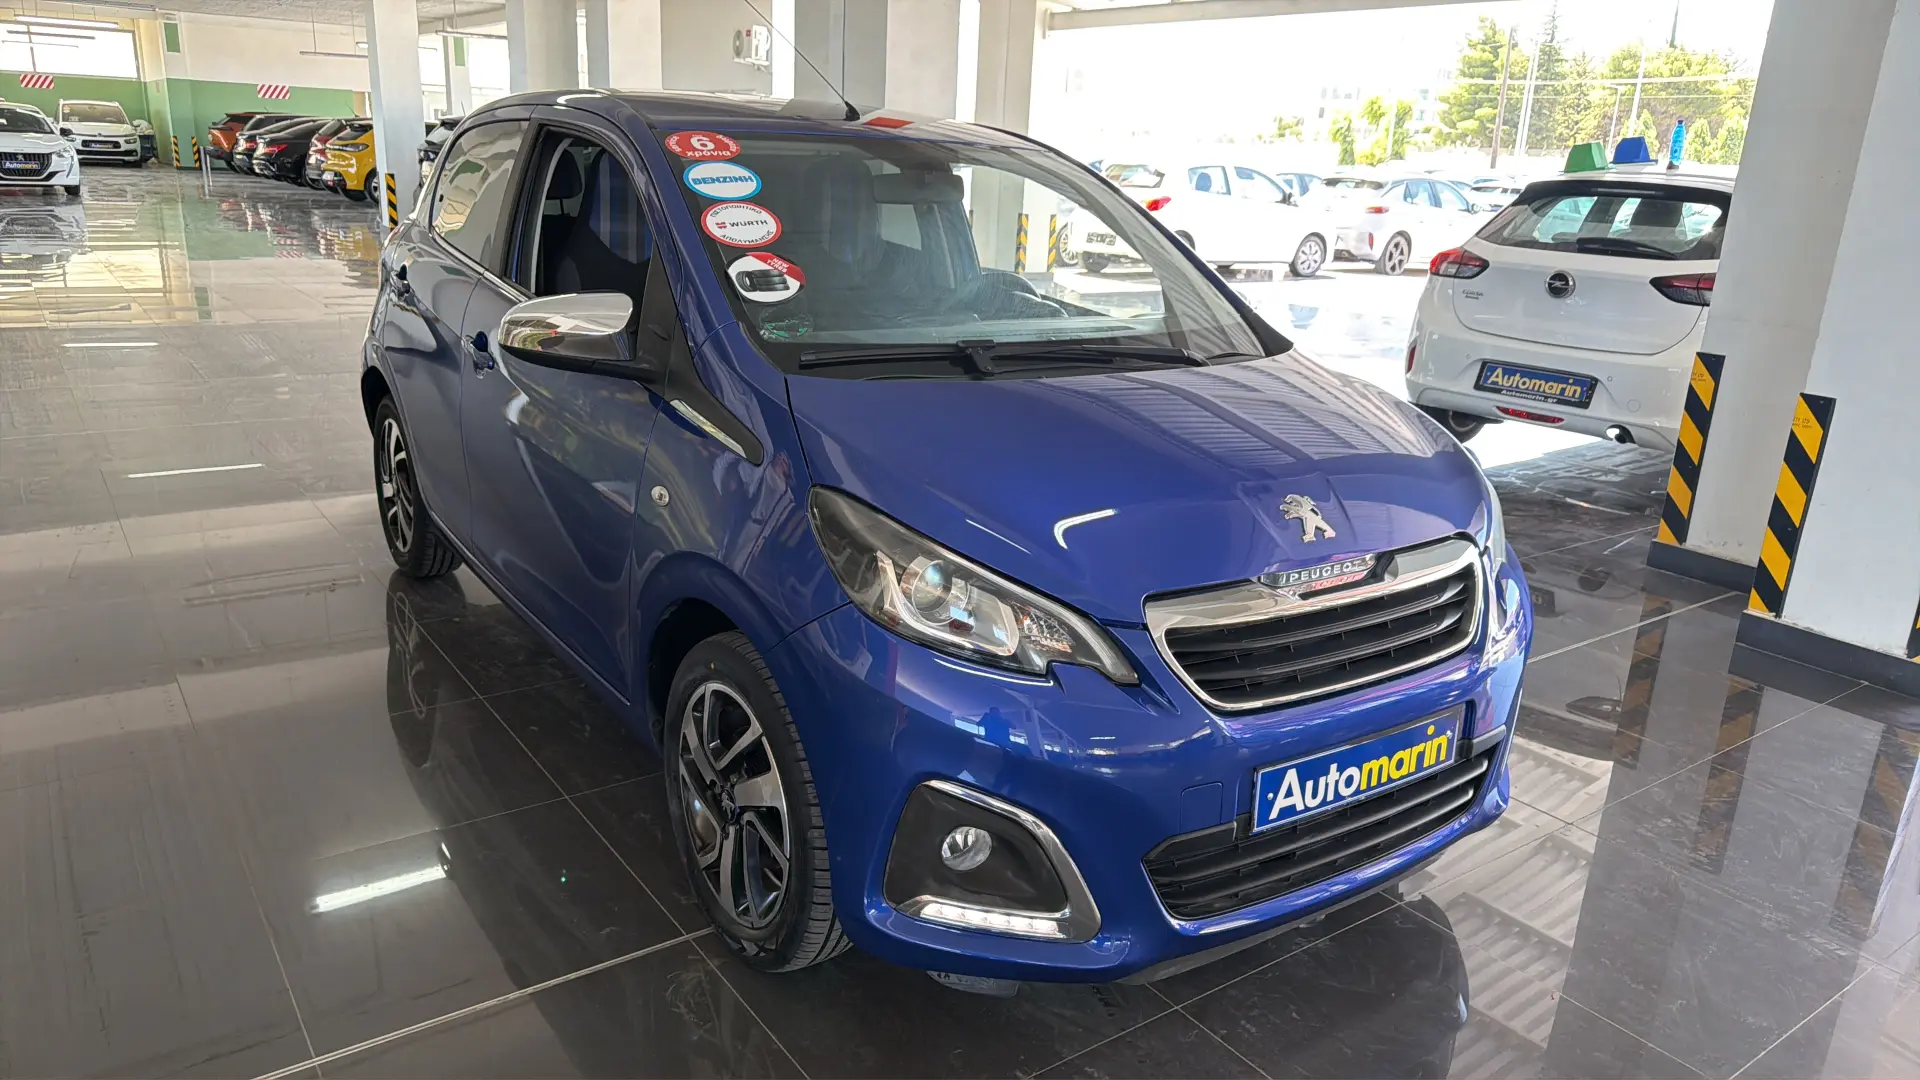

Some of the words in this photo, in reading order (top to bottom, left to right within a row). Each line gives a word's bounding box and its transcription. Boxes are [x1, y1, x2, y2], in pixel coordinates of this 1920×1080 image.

[690, 136, 715, 151] 6
[766, 259, 788, 273] TYRES
[772, 258, 789, 269] NEW
[1487, 367, 1582, 398] Automarin
[1501, 389, 1558, 404] Automarin.gr
[1289, 560, 1362, 583] PEUGEOT
[1268, 725, 1449, 820] Automarin
